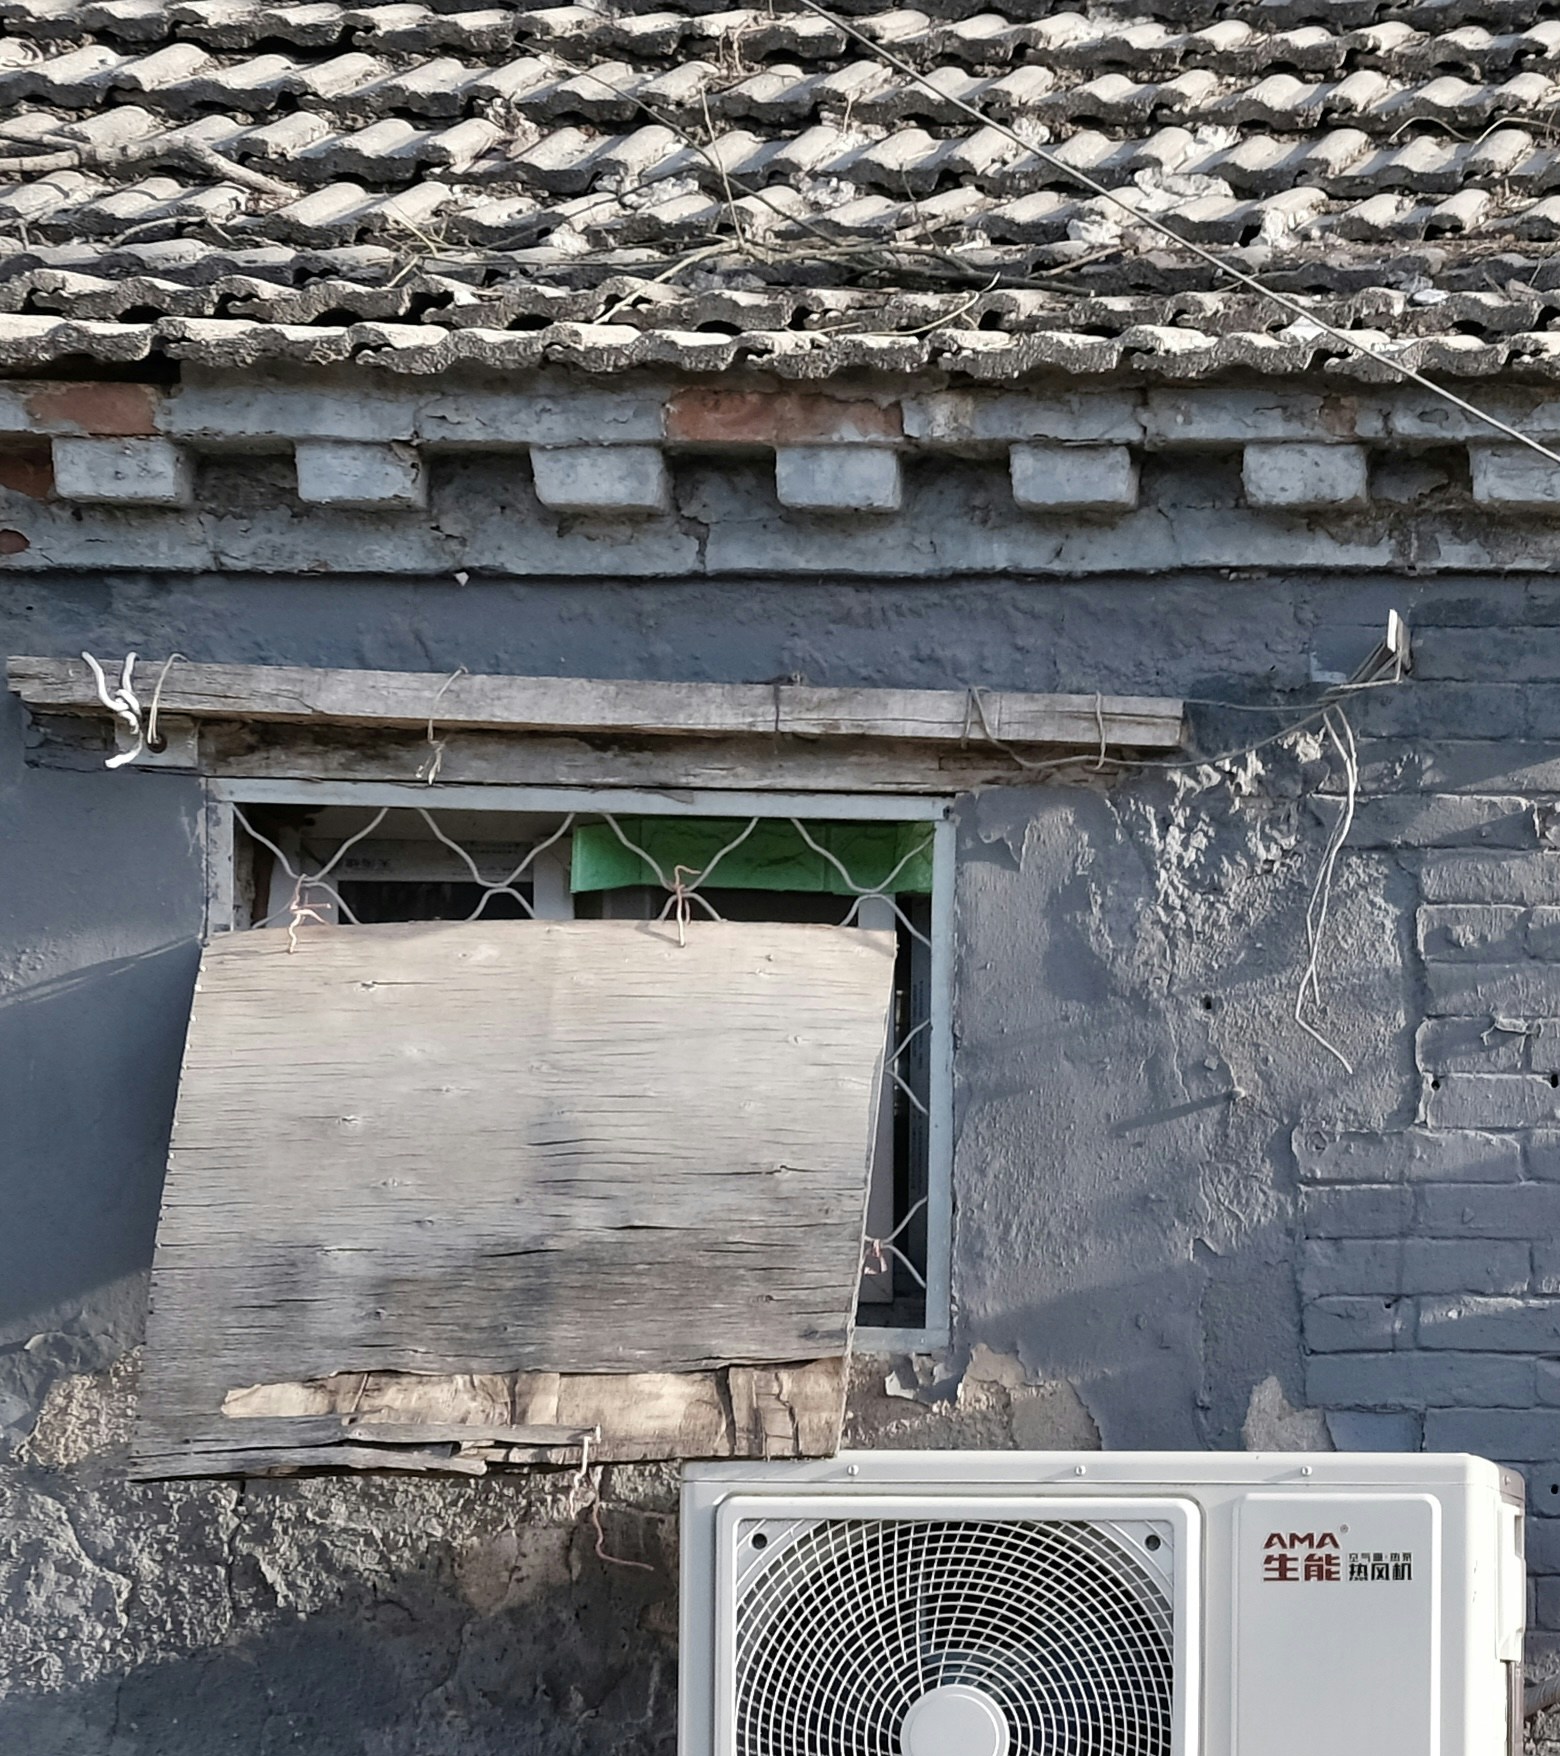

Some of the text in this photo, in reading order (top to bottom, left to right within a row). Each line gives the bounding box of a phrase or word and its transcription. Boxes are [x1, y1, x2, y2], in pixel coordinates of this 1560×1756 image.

[1263, 1532, 1340, 1549] AMA
[1263, 1553, 1341, 1581] 生能
[1349, 1563, 1412, 1581] 热风机
